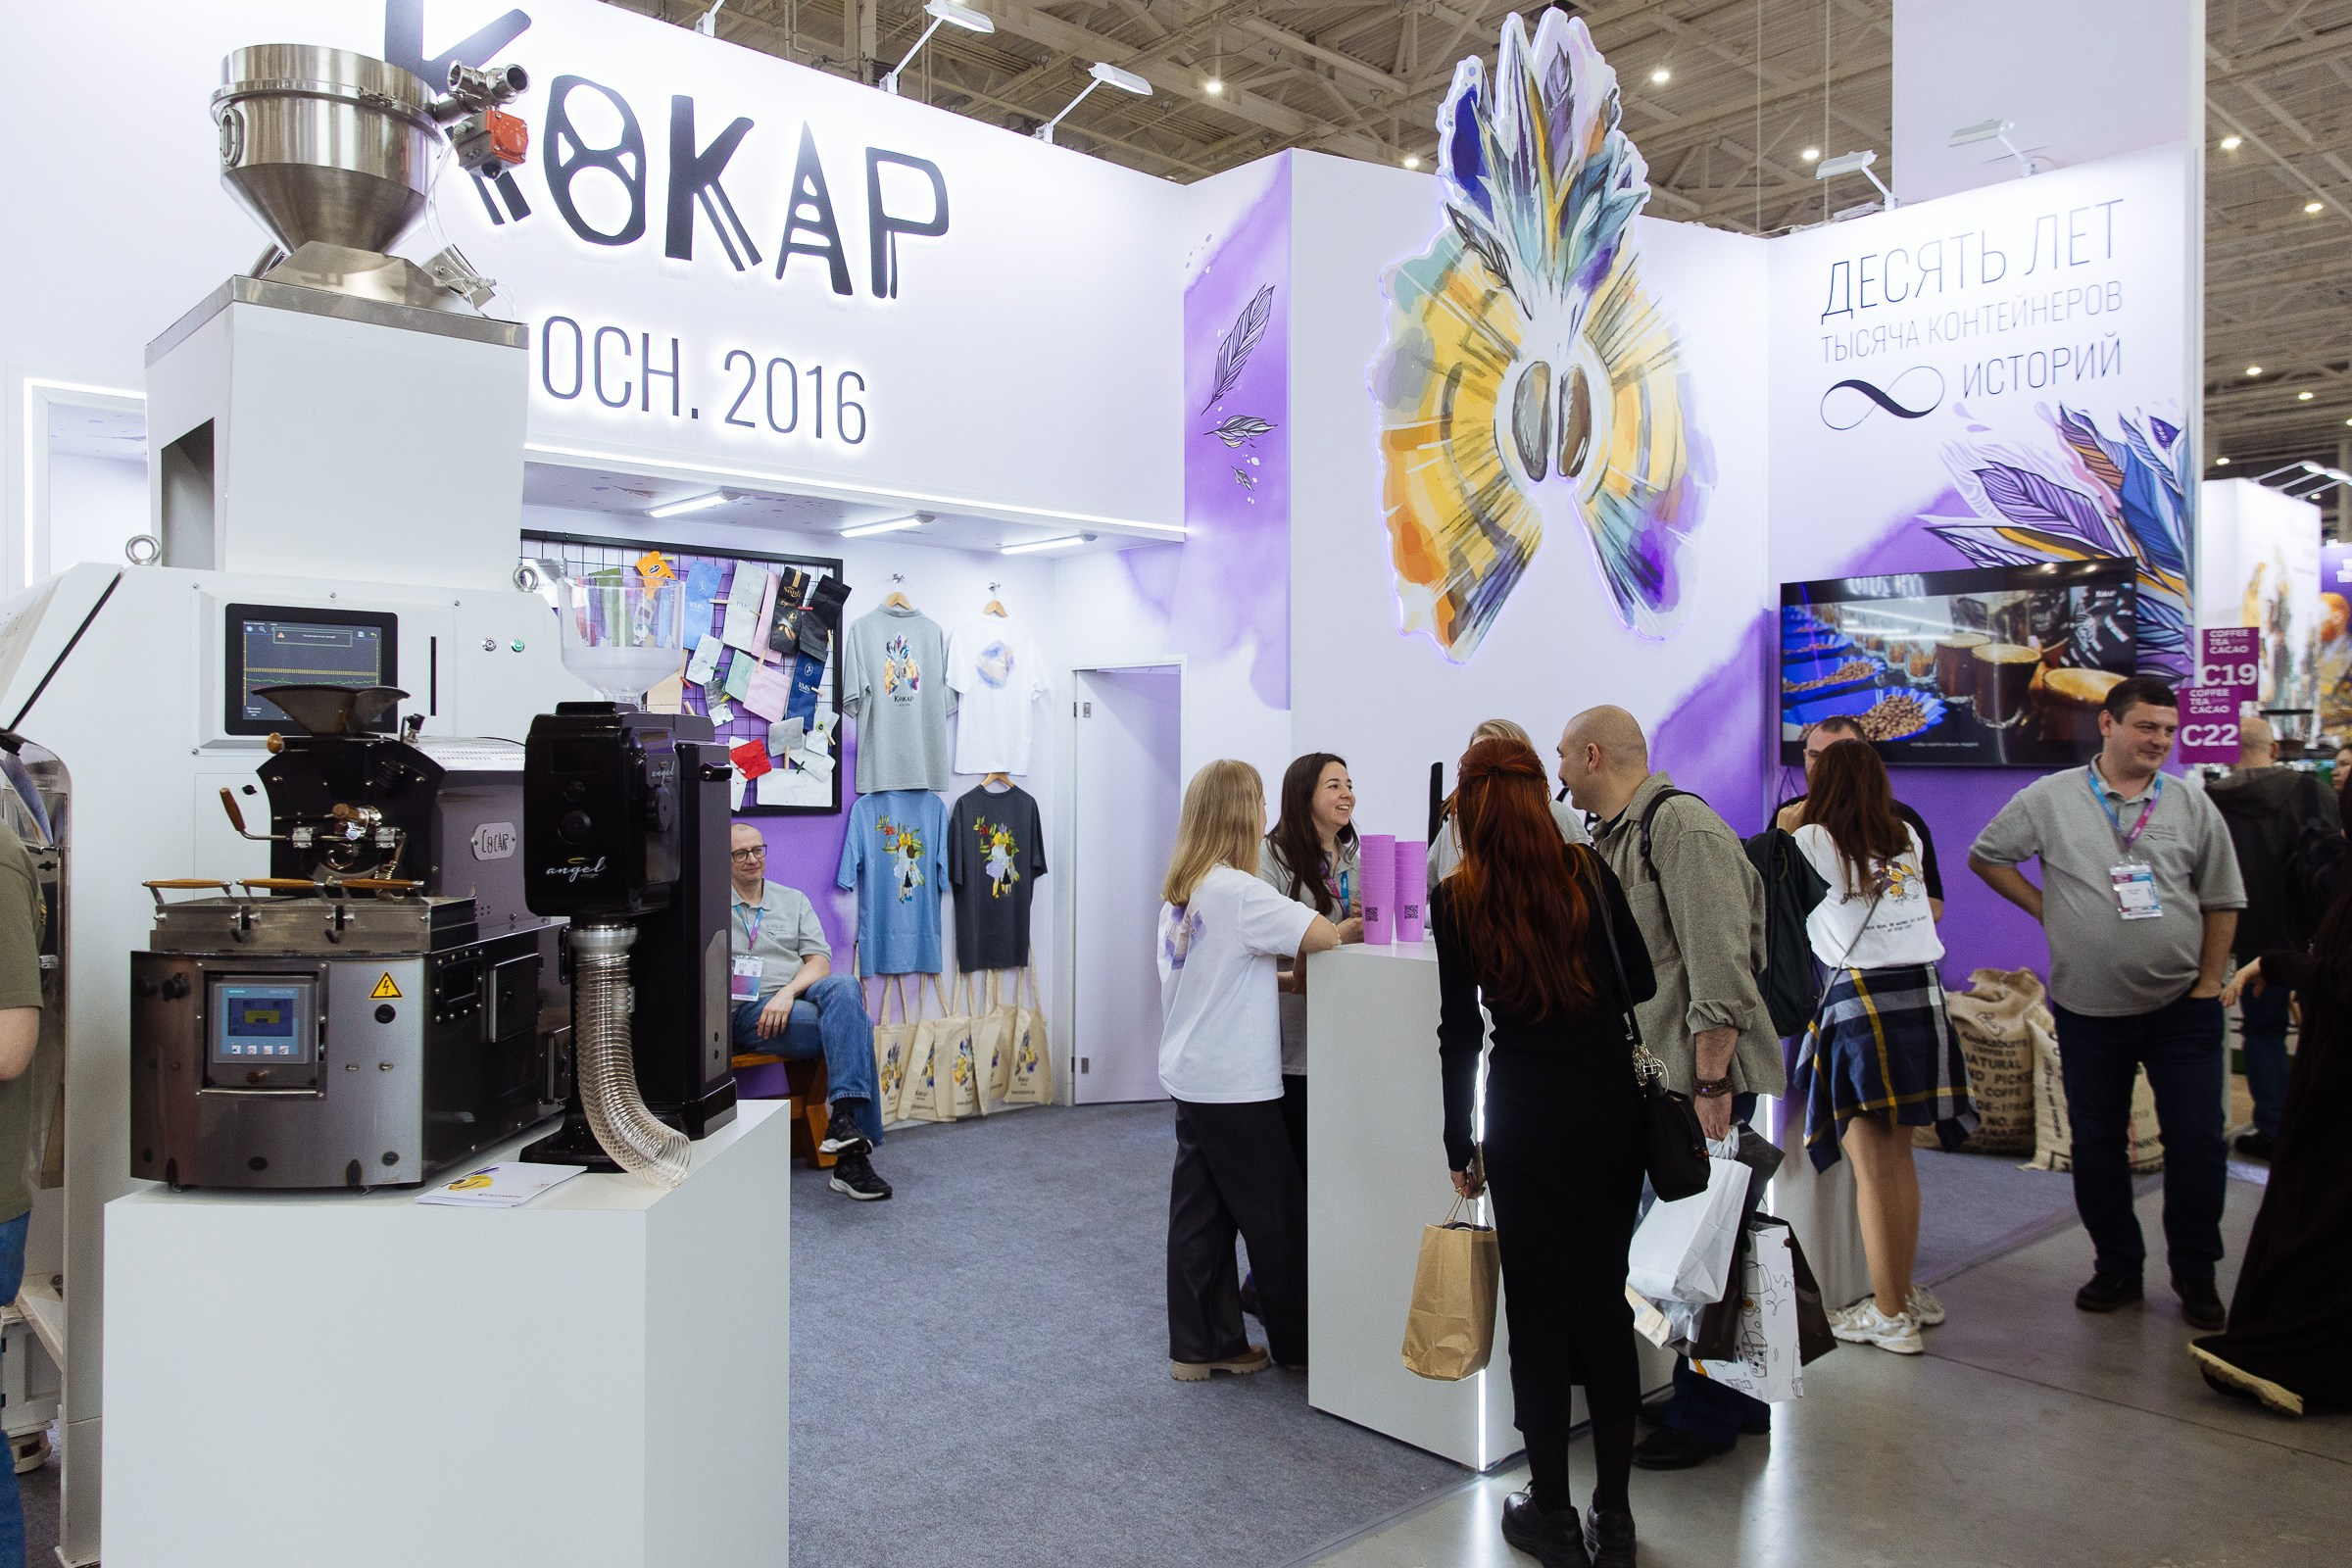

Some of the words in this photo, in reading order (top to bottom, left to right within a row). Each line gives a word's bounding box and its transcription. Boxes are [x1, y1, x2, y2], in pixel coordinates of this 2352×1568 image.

[1821, 229, 2007, 325] ДЕСЯТЬ
[2025, 199, 2124, 275] ЛЕТ
[1821, 319, 1920, 364] ТЫСЯЧА
[1929, 280, 2123, 345] КОНТЕЙНЕРОВ
[1963, 331, 2122, 399] ИСТОРИЙ
[541, 315, 700, 420] ОСН.
[723, 349, 867, 446] 2016
[2209, 645, 2249, 654] CACAO
[2201, 663, 2258, 686] C19
[2189, 688, 2230, 697] COFFEE
[2180, 723, 2238, 747] C22
[546, 856, 608, 882] angel
